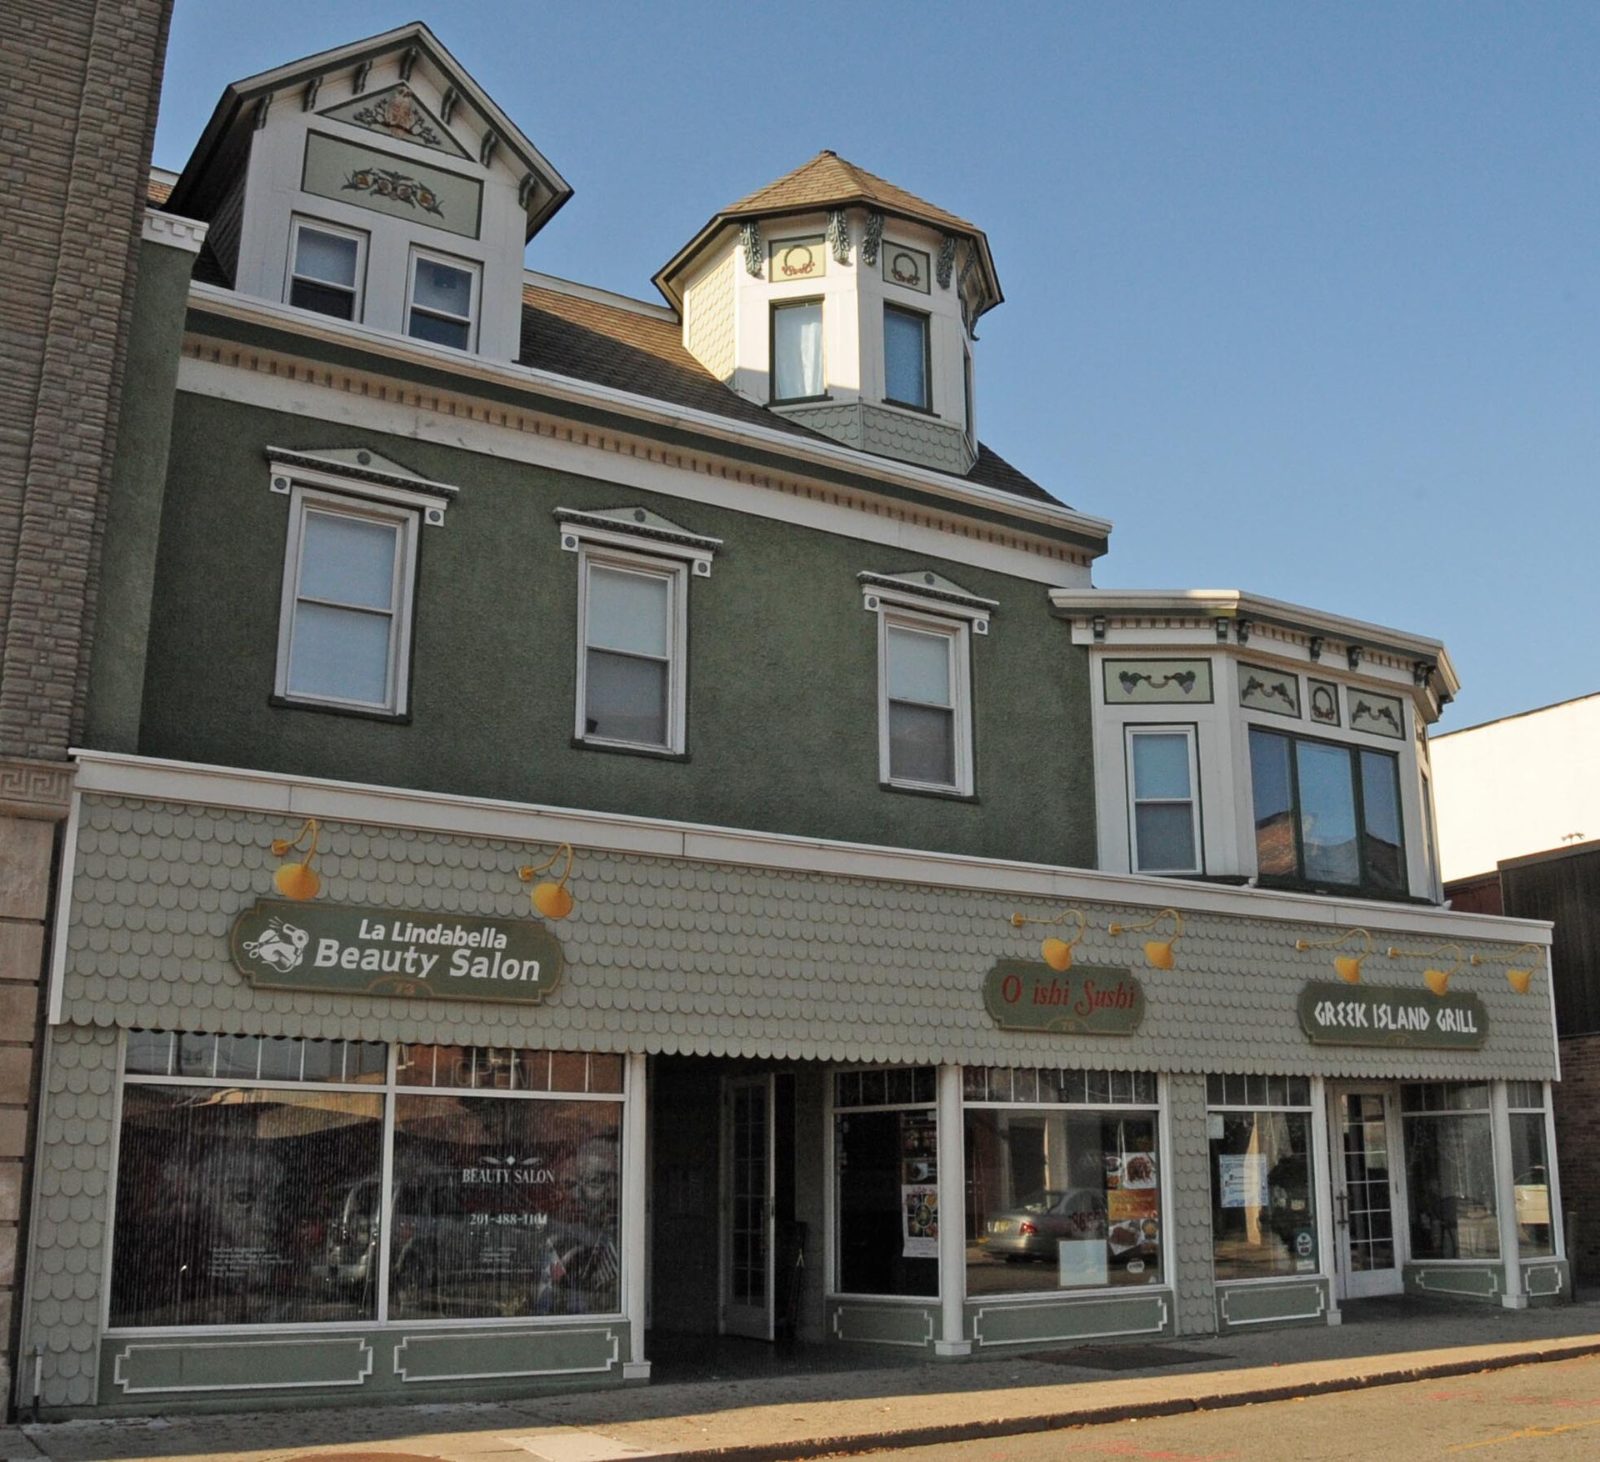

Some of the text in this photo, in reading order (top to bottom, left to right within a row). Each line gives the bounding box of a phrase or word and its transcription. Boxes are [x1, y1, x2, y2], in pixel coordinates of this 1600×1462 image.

[358, 918, 508, 949] La Lindabella
[313, 938, 541, 981] Beauty Salon
[1074, 979, 1136, 1017] Sushi
[1314, 1000, 1478, 1033] GREEK ISLAND GRILL
[455, 1060, 530, 1089] OPEN
[462, 1168, 555, 1184] BEAUTY SALON
